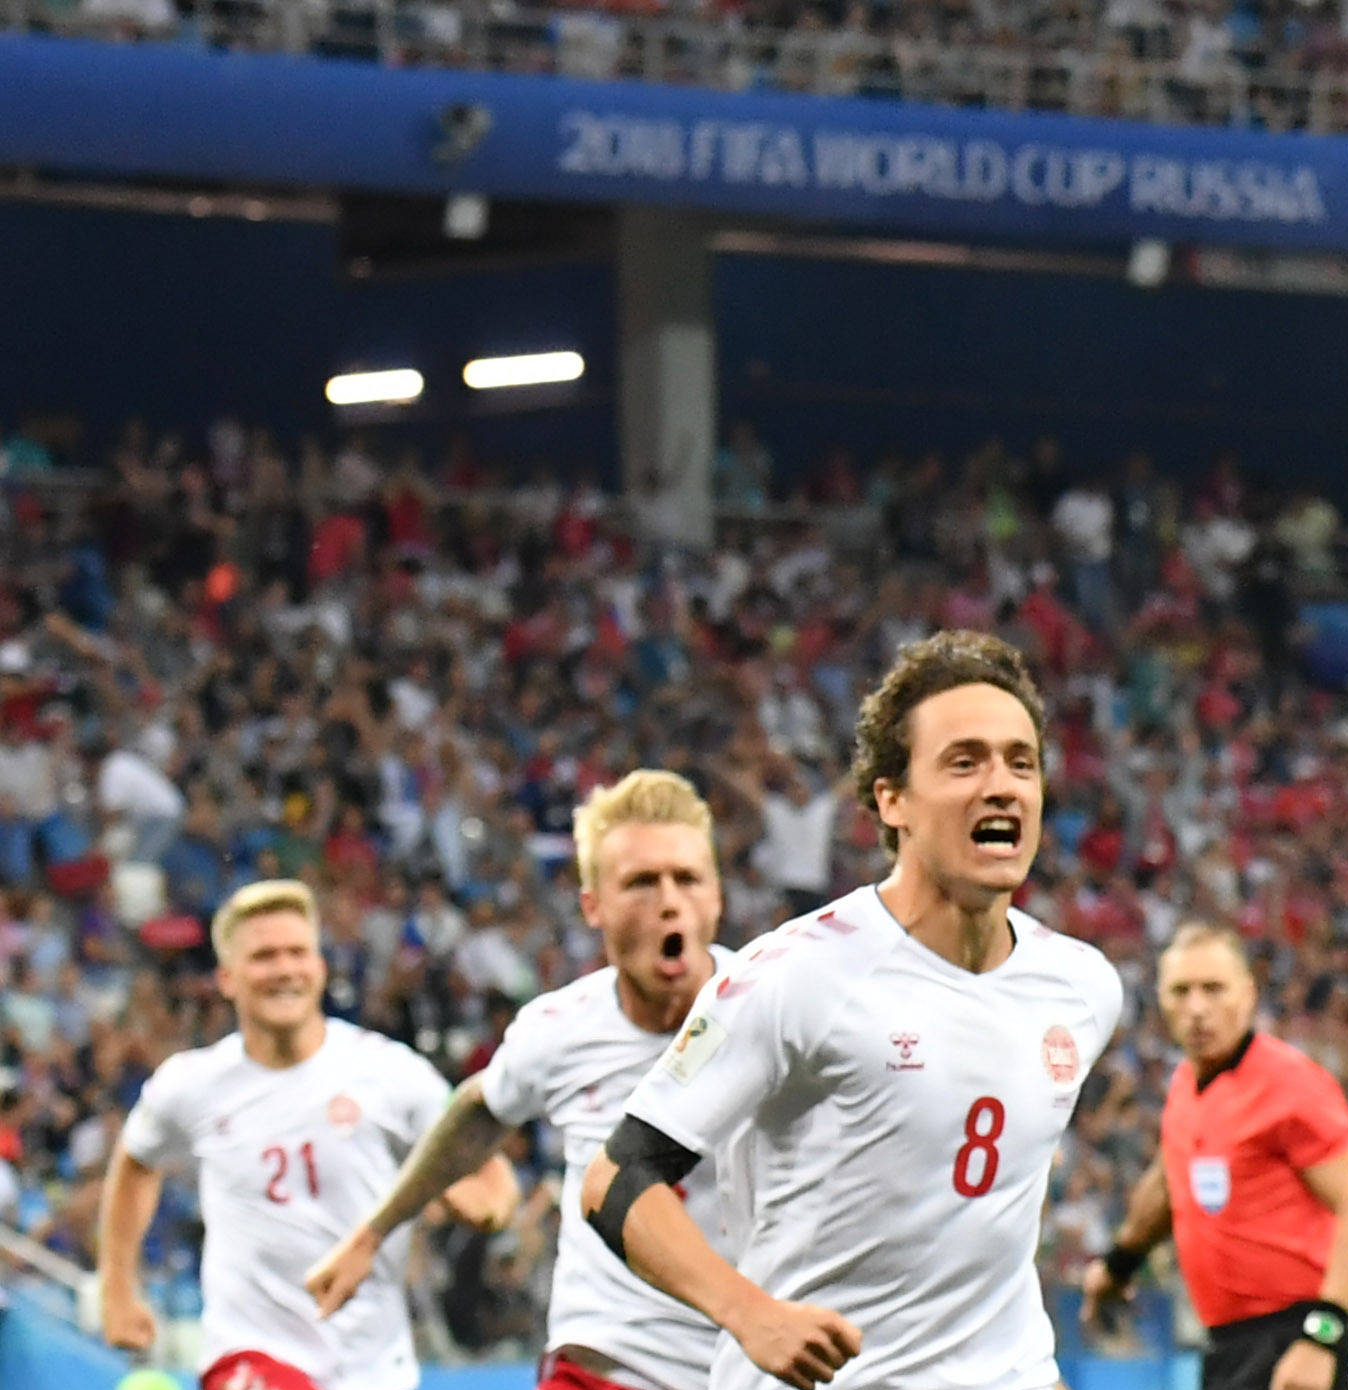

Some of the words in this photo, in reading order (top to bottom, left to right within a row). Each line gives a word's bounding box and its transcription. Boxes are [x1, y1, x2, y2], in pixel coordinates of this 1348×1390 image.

[557, 110, 684, 180] 2018
[687, 117, 808, 187] FIFA
[812, 130, 1007, 203] WORLD
[1010, 142, 1127, 208] CUP
[1128, 155, 1325, 224] RUSSIA
[264, 1142, 319, 1204] 21
[953, 1095, 1006, 1198] 8
